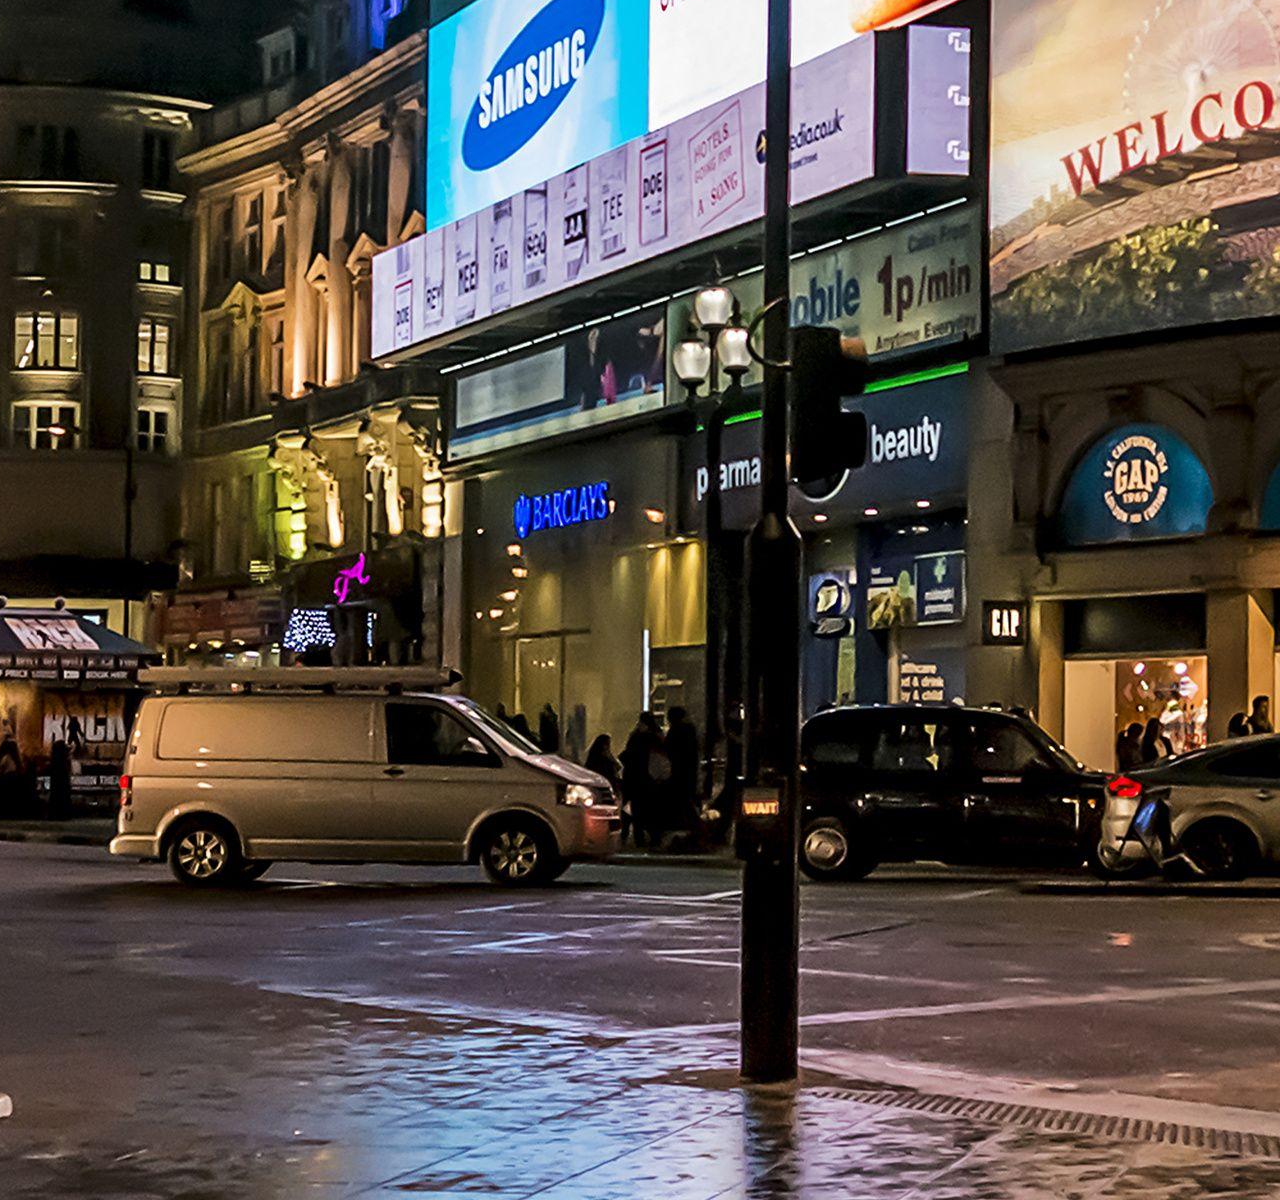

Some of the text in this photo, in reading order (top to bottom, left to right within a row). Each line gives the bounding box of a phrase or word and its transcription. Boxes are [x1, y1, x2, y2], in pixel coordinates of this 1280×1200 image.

[478, 29, 585, 129] SAMSUNG
[694, 122, 730, 163] HOTELS
[642, 171, 663, 198] DOE
[697, 171, 738, 217] A SONG
[602, 193, 624, 226] TEE
[791, 268, 861, 327] obile
[871, 416, 941, 464] beauty
[1114, 459, 1159, 495] GAP
[532, 480, 610, 531] BARCLAYS
[1122, 491, 1149, 504] 1969
[991, 608, 1021, 638] GAP
[743, 801, 776, 815] WAIT
